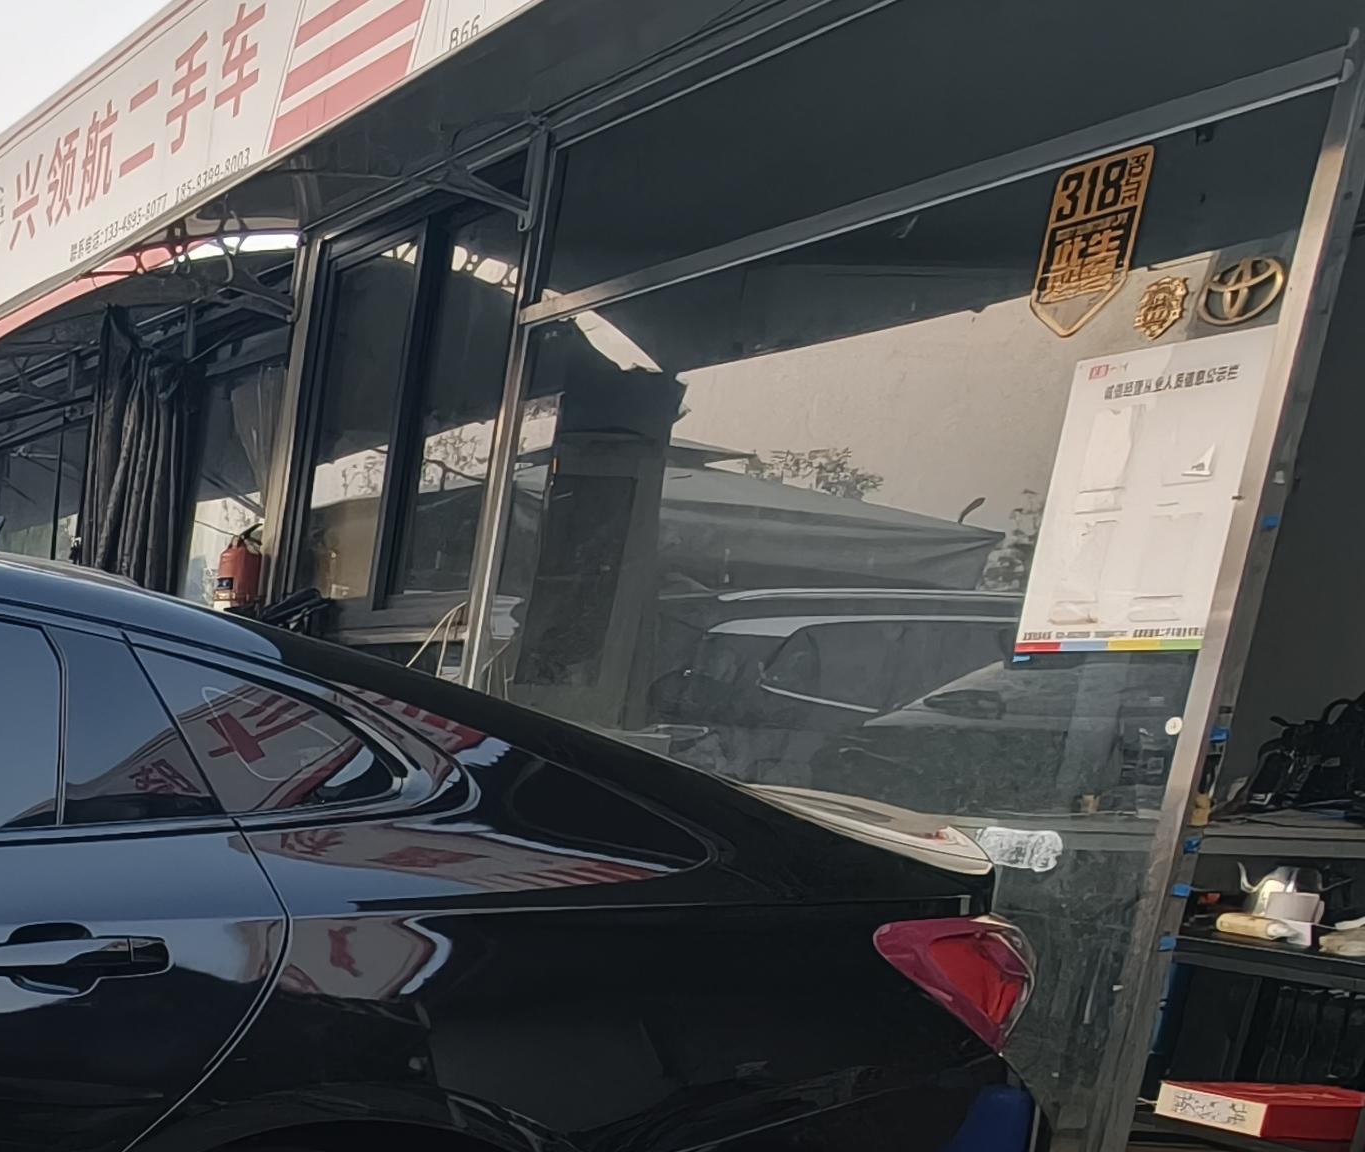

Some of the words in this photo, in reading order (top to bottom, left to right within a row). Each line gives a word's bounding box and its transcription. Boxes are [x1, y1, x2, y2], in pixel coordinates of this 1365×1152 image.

[9, 3, 267, 250] 兴领航二手车
[1055, 157, 1129, 223] 318
